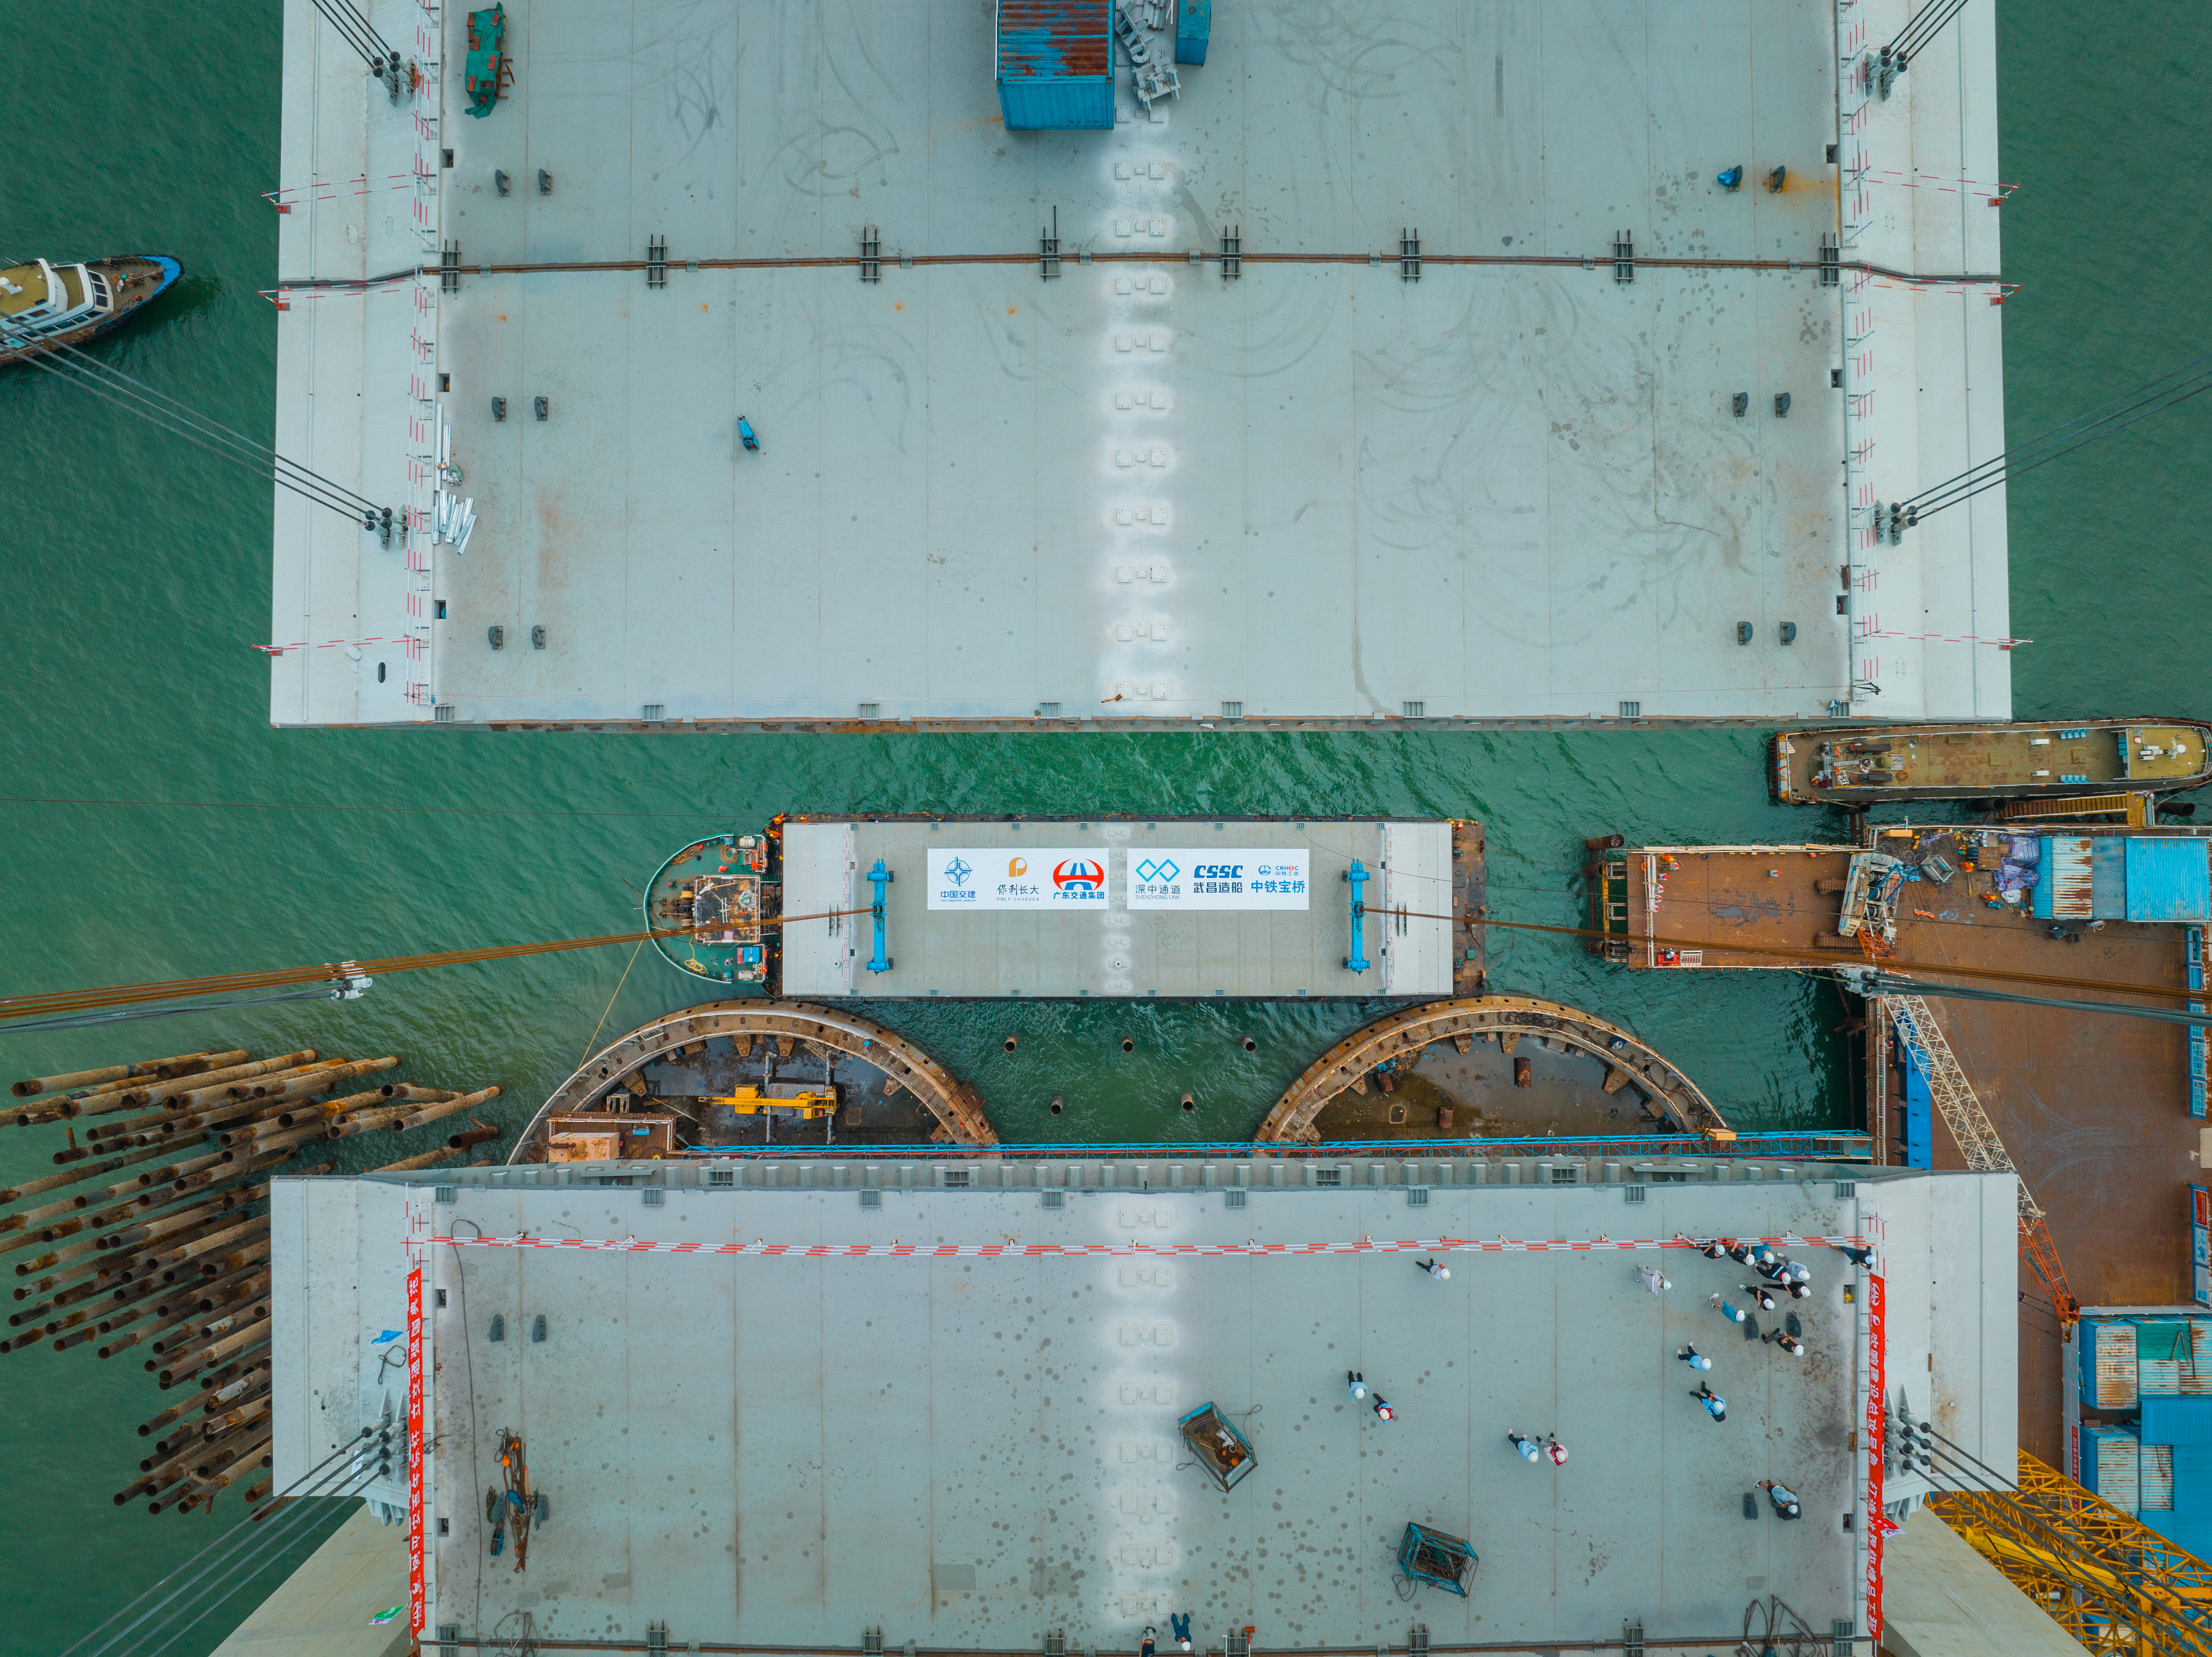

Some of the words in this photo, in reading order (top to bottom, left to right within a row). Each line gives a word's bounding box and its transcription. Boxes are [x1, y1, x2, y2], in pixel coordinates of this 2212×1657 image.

[1194, 865, 1243, 878] CSSC
[997, 884, 1039, 896] 保利长大
[1135, 884, 1180, 894] 深中通道
[1193, 882, 1243, 893] 武昌造船
[1251, 880, 1305, 894] 中铁宝桥
[1053, 891, 1105, 900] 广东交通集团
[2028, 1256, 2048, 1284] ZOOMLION
[410, 1276, 421, 1419] 立交通强国典范
[1868, 1332, 1879, 1466] 吹响建设总攻号角
[410, 1430, 421, 1572] 树平安百年标杆
[1867, 1479, 1878, 1634] 打造世界级精品工程
